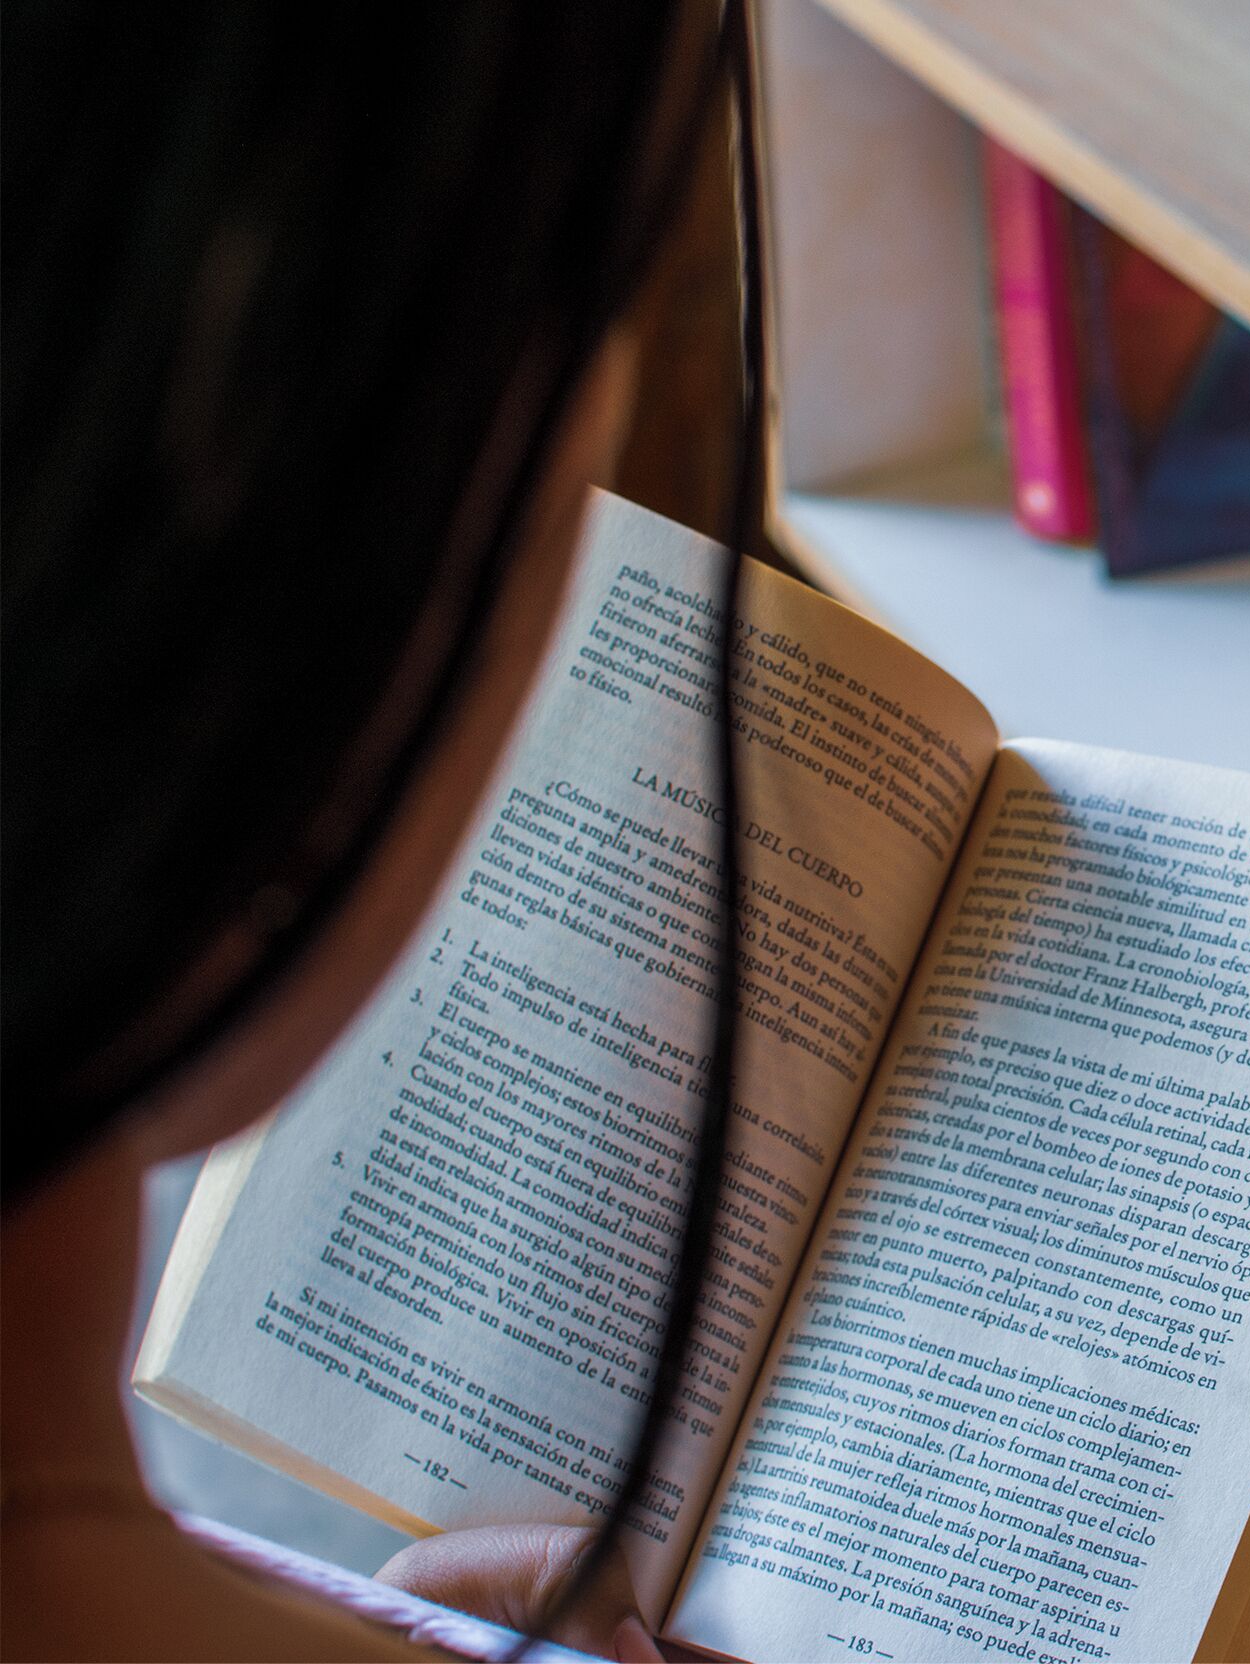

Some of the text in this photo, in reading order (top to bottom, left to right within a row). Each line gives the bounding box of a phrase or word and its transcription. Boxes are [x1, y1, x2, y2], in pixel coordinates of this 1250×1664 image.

[598, 604, 658, 640] firieron
[568, 664, 632, 704] to físico.
[761, 684, 872, 751] «madre» suave
[506, 787, 647, 863] pregunta amplia y
[631, 766, 863, 898] LA MÚSIC DEL CUERPO
[1150, 833, 1225, 857] momento
[1227, 844, 1247, 862] de
[460, 886, 528, 931] de todos:
[468, 869, 645, 963] gunas reglas básicas que
[489, 823, 690, 934] lleven vidas idénticas o que
[1029, 953, 1082, 978] doctor
[1081, 965, 1129, 991] Franz
[1129, 977, 1207, 1012] Halbergh,
[1124, 914, 1175, 937] nueva,
[1177, 920, 1237, 949] llamada
[467, 939, 489, 963] La
[489, 950, 576, 1007] inteligencia
[577, 1000, 611, 1023] está
[609, 1010, 657, 1047] hecha
[656, 1040, 695, 1066] para
[744, 1006, 825, 1059] inteligencia
[1052, 1002, 1109, 1031] interna
[1110, 1022, 1141, 1039] que
[1139, 1029, 1214, 1057] podemos
[1215, 1043, 1234, 1064] (y
[424, 1025, 685, 1164] y ciclos complejos; estos biorritmos
[991, 1100, 1047, 1127] cientos
[1047, 1114, 1068, 1134] de
[1071, 1125, 1112, 1145] veces
[1109, 1137, 1143, 1153] por
[1142, 1145, 1209, 1171] segundo
[1210, 1163, 1241, 1180] con
[378, 1127, 636, 1268] na está en relación armoniosa con su
[937, 1153, 959, 1173] las
[961, 1160, 1039, 1195] diferentes
[1040, 1187, 1115, 1217] neuronas
[1118, 1204, 1187, 1237] disparan
[319, 1244, 443, 1325] lleva al desorden.
[338, 1204, 637, 1373] formación biológica. Vivir en oposición
[922, 1223, 1243, 1324] se estremecen constantemente, como un
[298, 1285, 611, 1464] Si mi intención es vivir en armonía con mi
[832, 1311, 1200, 1435] biorritmos tienen muchas implicaciones médicas:
[861, 1272, 1217, 1390] increíblemente rápidas de «relojes» atómicos en
[255, 1314, 573, 1496] de mi cuerpo. Pasamos en la vida por tantas
[837, 1359, 1182, 1477] hormonas, se mueven en ciclos complejamen-
[827, 1457, 1147, 1567] mujer refleja ritmos hormonales mensua-
[853, 1417, 1165, 1522] estacionales. (La hormona del crecimien-
[772, 1536, 1111, 1658] calmantes. La presión sanguínea y la adrena-
[779, 1487, 1129, 1612] inflamatorios naturales del cuerpo parecen es-
